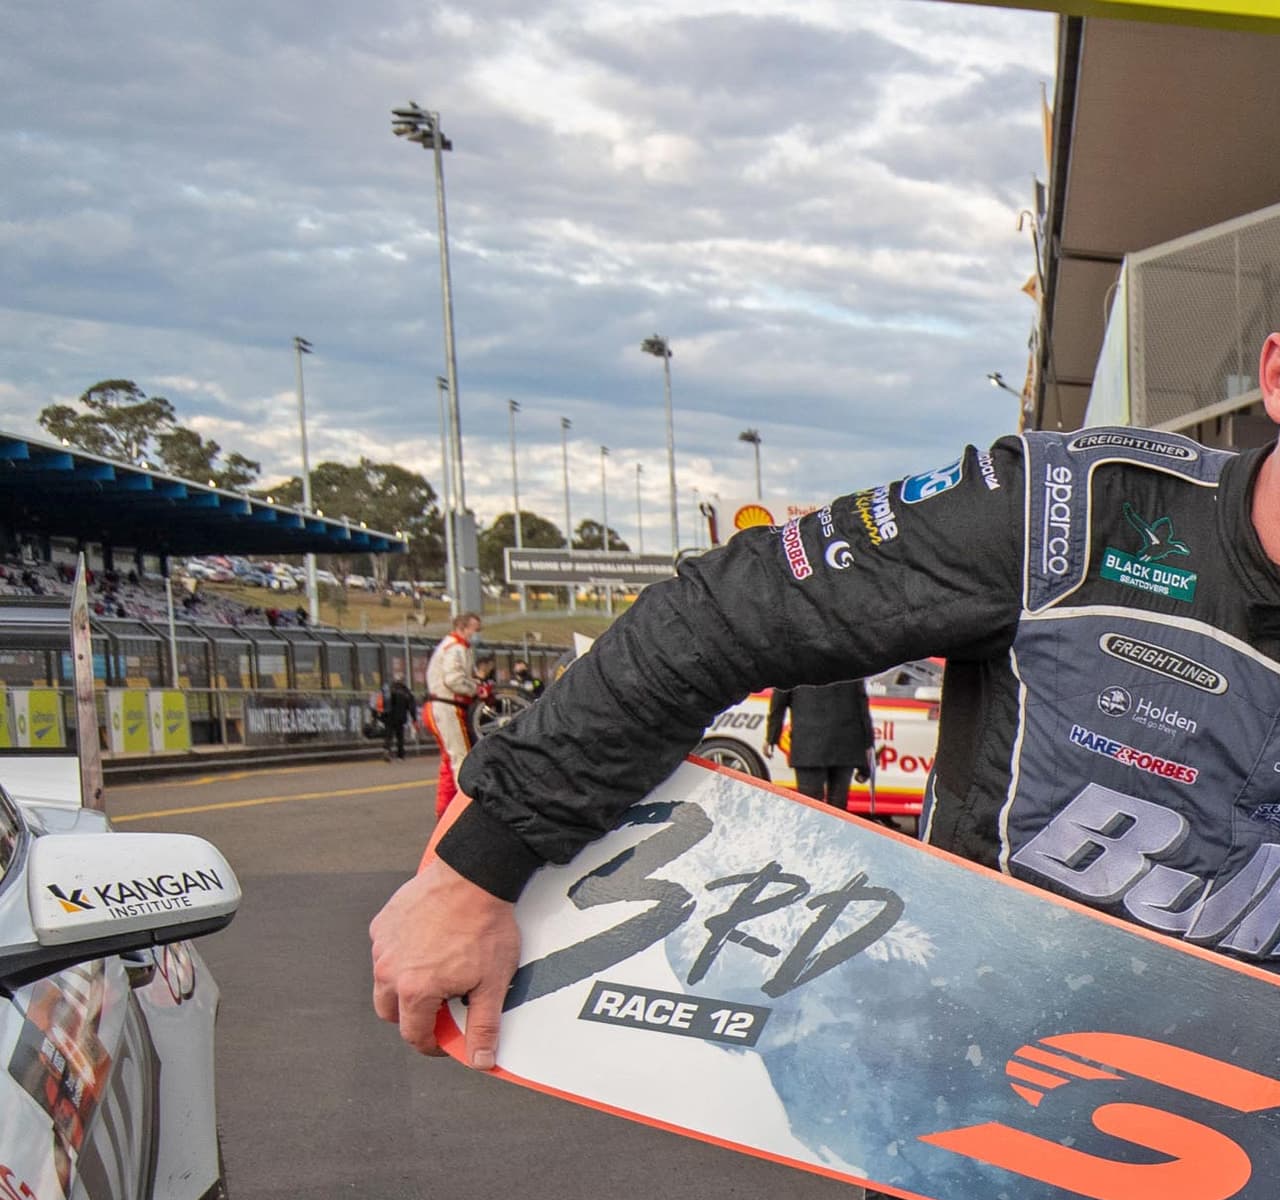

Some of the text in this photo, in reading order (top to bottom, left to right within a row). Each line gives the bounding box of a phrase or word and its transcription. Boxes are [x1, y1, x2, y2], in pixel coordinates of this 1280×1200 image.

[1079, 434, 1185, 457] FREIGHTLINER
[1046, 467, 1072, 575] sparco
[1106, 555, 1190, 590] BLACK DUCK
[1120, 575, 1169, 595] SEATCOVERS
[1111, 639, 1216, 688] FREIGHTLINER
[1136, 698, 1197, 733] Holden
[94, 869, 223, 907] KANGAN
[109, 896, 192, 918] INSTITUTE
[502, 801, 904, 1014] 3RD
[594, 990, 754, 1038] RACE 12
